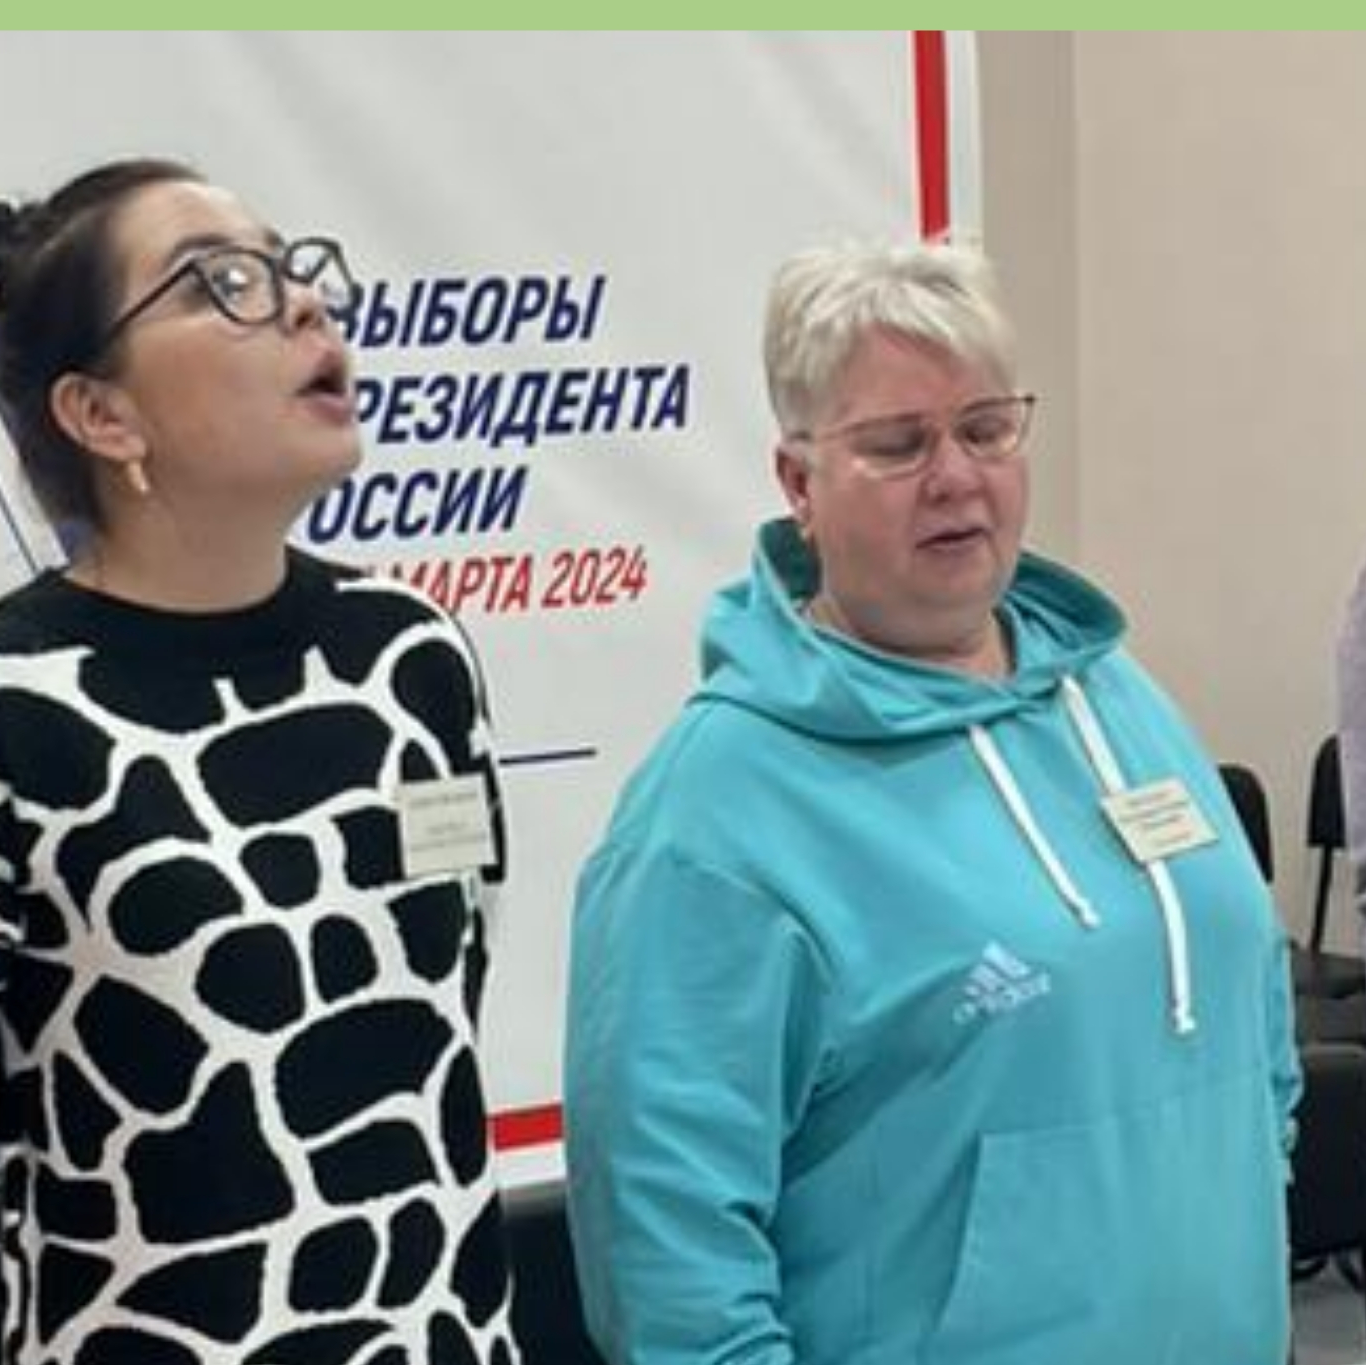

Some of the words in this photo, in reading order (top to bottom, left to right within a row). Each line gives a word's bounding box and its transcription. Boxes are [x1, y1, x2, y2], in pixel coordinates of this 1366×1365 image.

[354, 363, 690, 448] РЕЗИДЕНТА
[307, 465, 528, 543] ОССИИ
[541, 545, 647, 607] 2024
